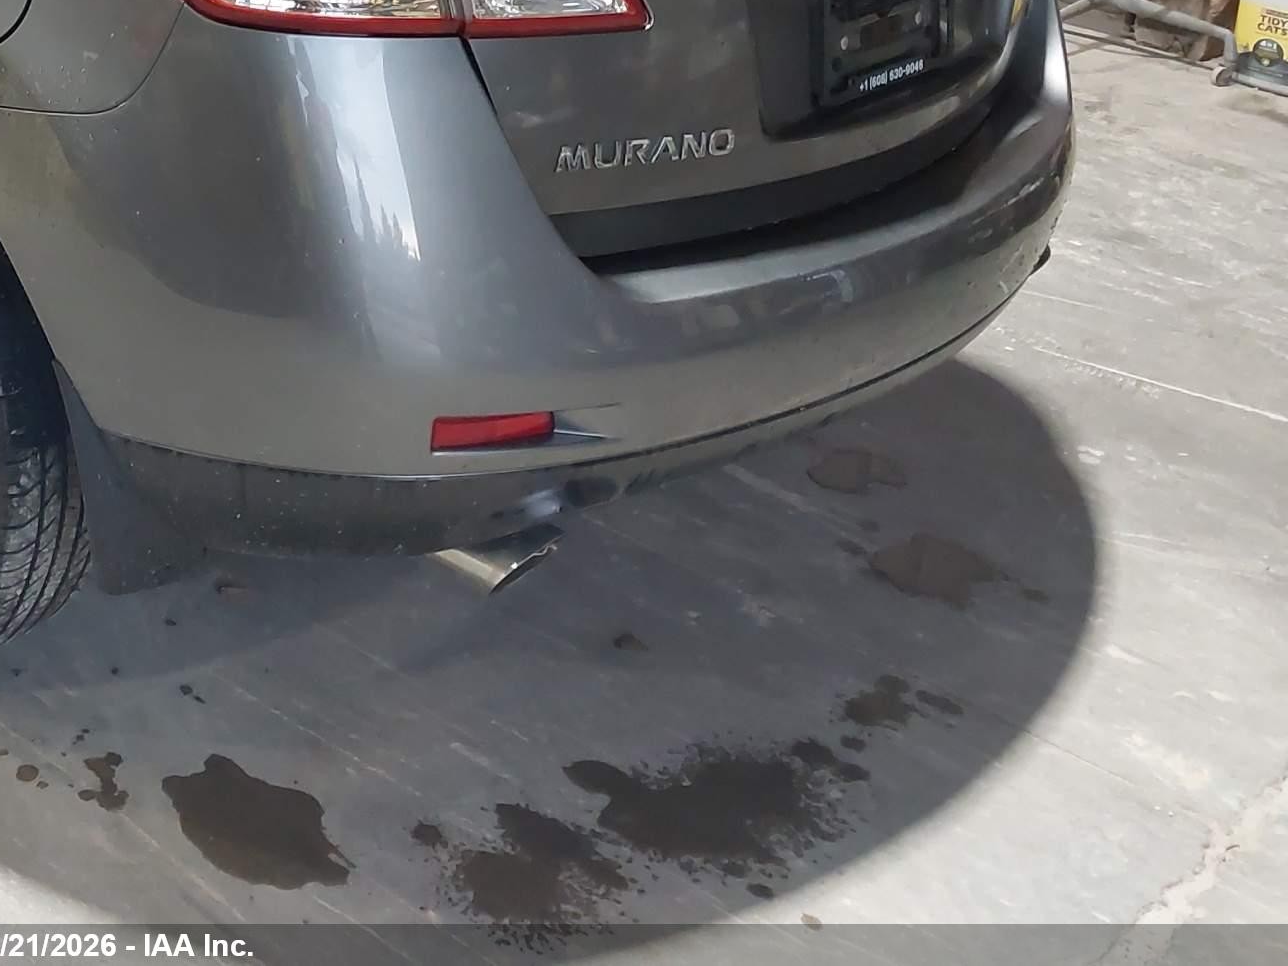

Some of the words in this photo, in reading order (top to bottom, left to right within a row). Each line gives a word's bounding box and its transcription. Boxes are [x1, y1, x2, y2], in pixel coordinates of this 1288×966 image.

[1259, 14, 1288, 28] TIDY
[1257, 22, 1288, 36] CATS
[859, 77, 869, 92] +1
[554, 128, 735, 174] MURANO
